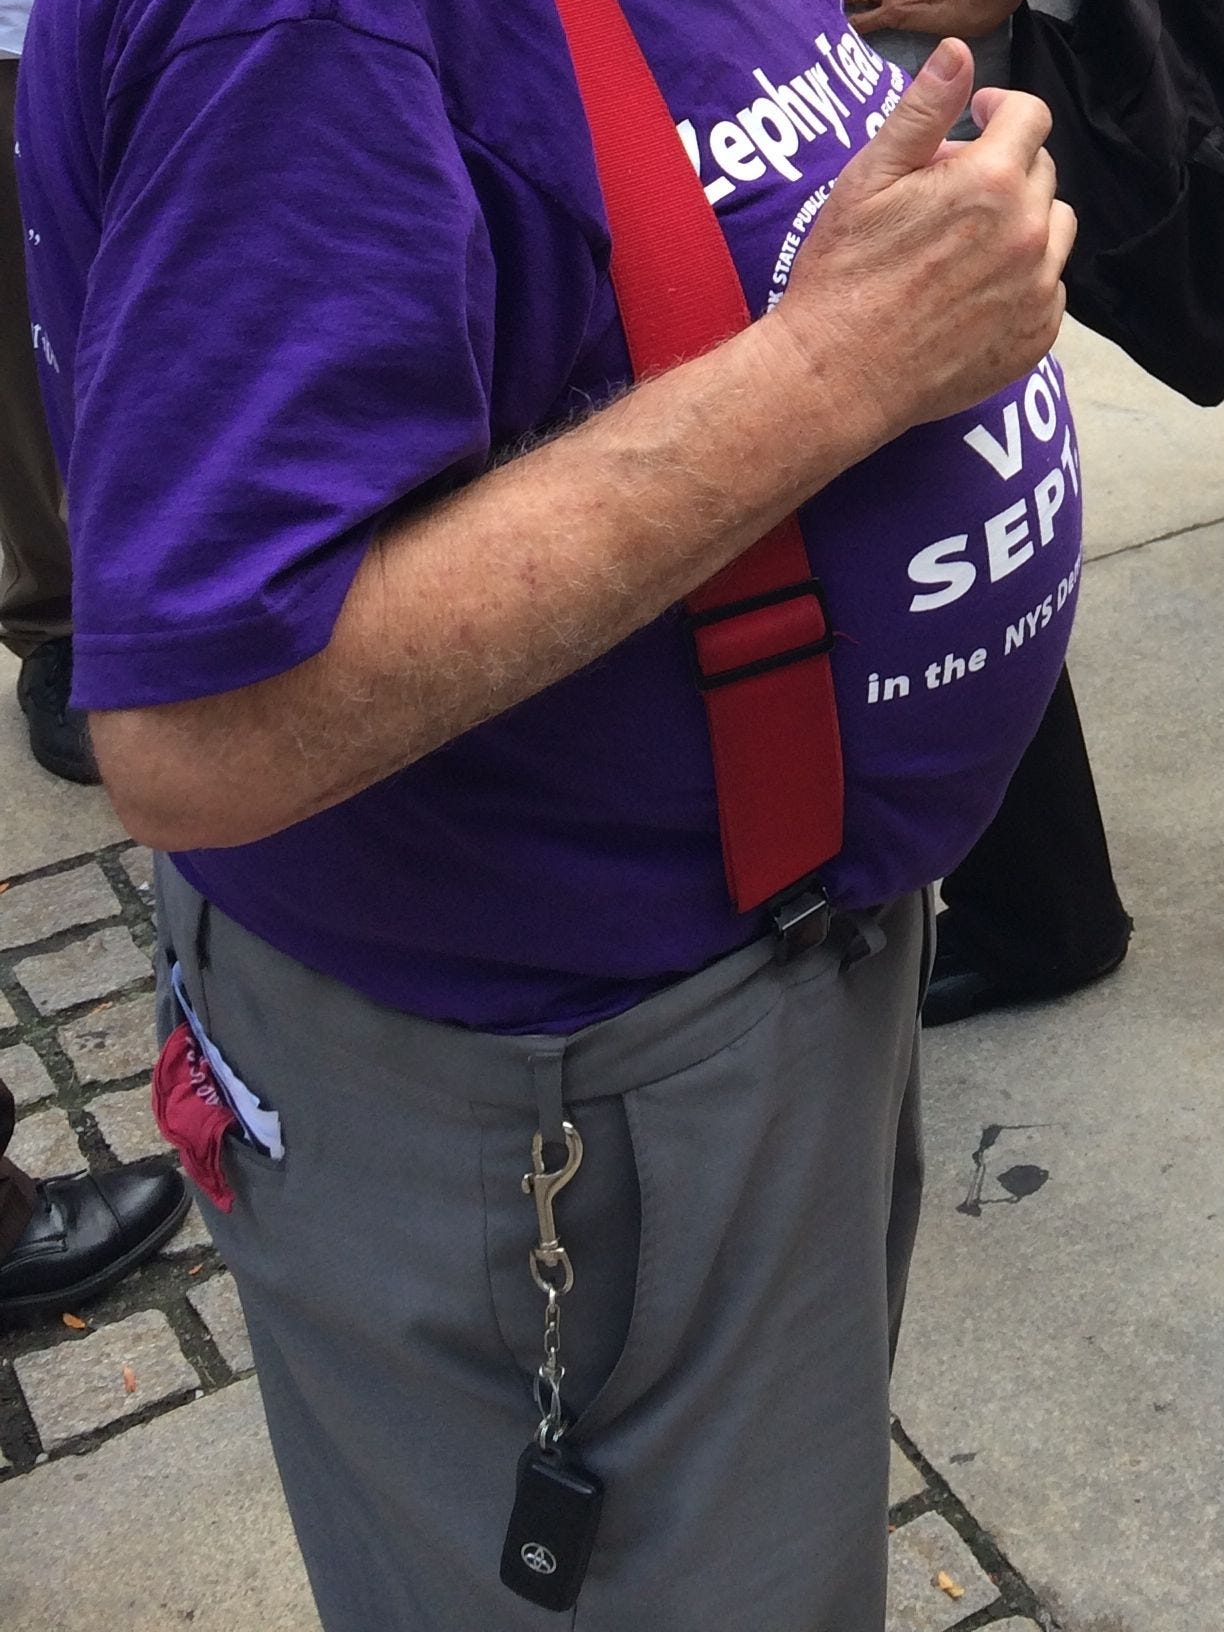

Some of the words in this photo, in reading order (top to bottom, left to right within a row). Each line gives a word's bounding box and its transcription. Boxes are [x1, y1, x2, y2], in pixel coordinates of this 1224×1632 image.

[772, 231, 801, 286] STATE
[792, 185, 832, 233] PUBLIC
[867, 672, 910, 704] in
[925, 647, 988, 690] the
[1004, 594, 1054, 656] NYS
